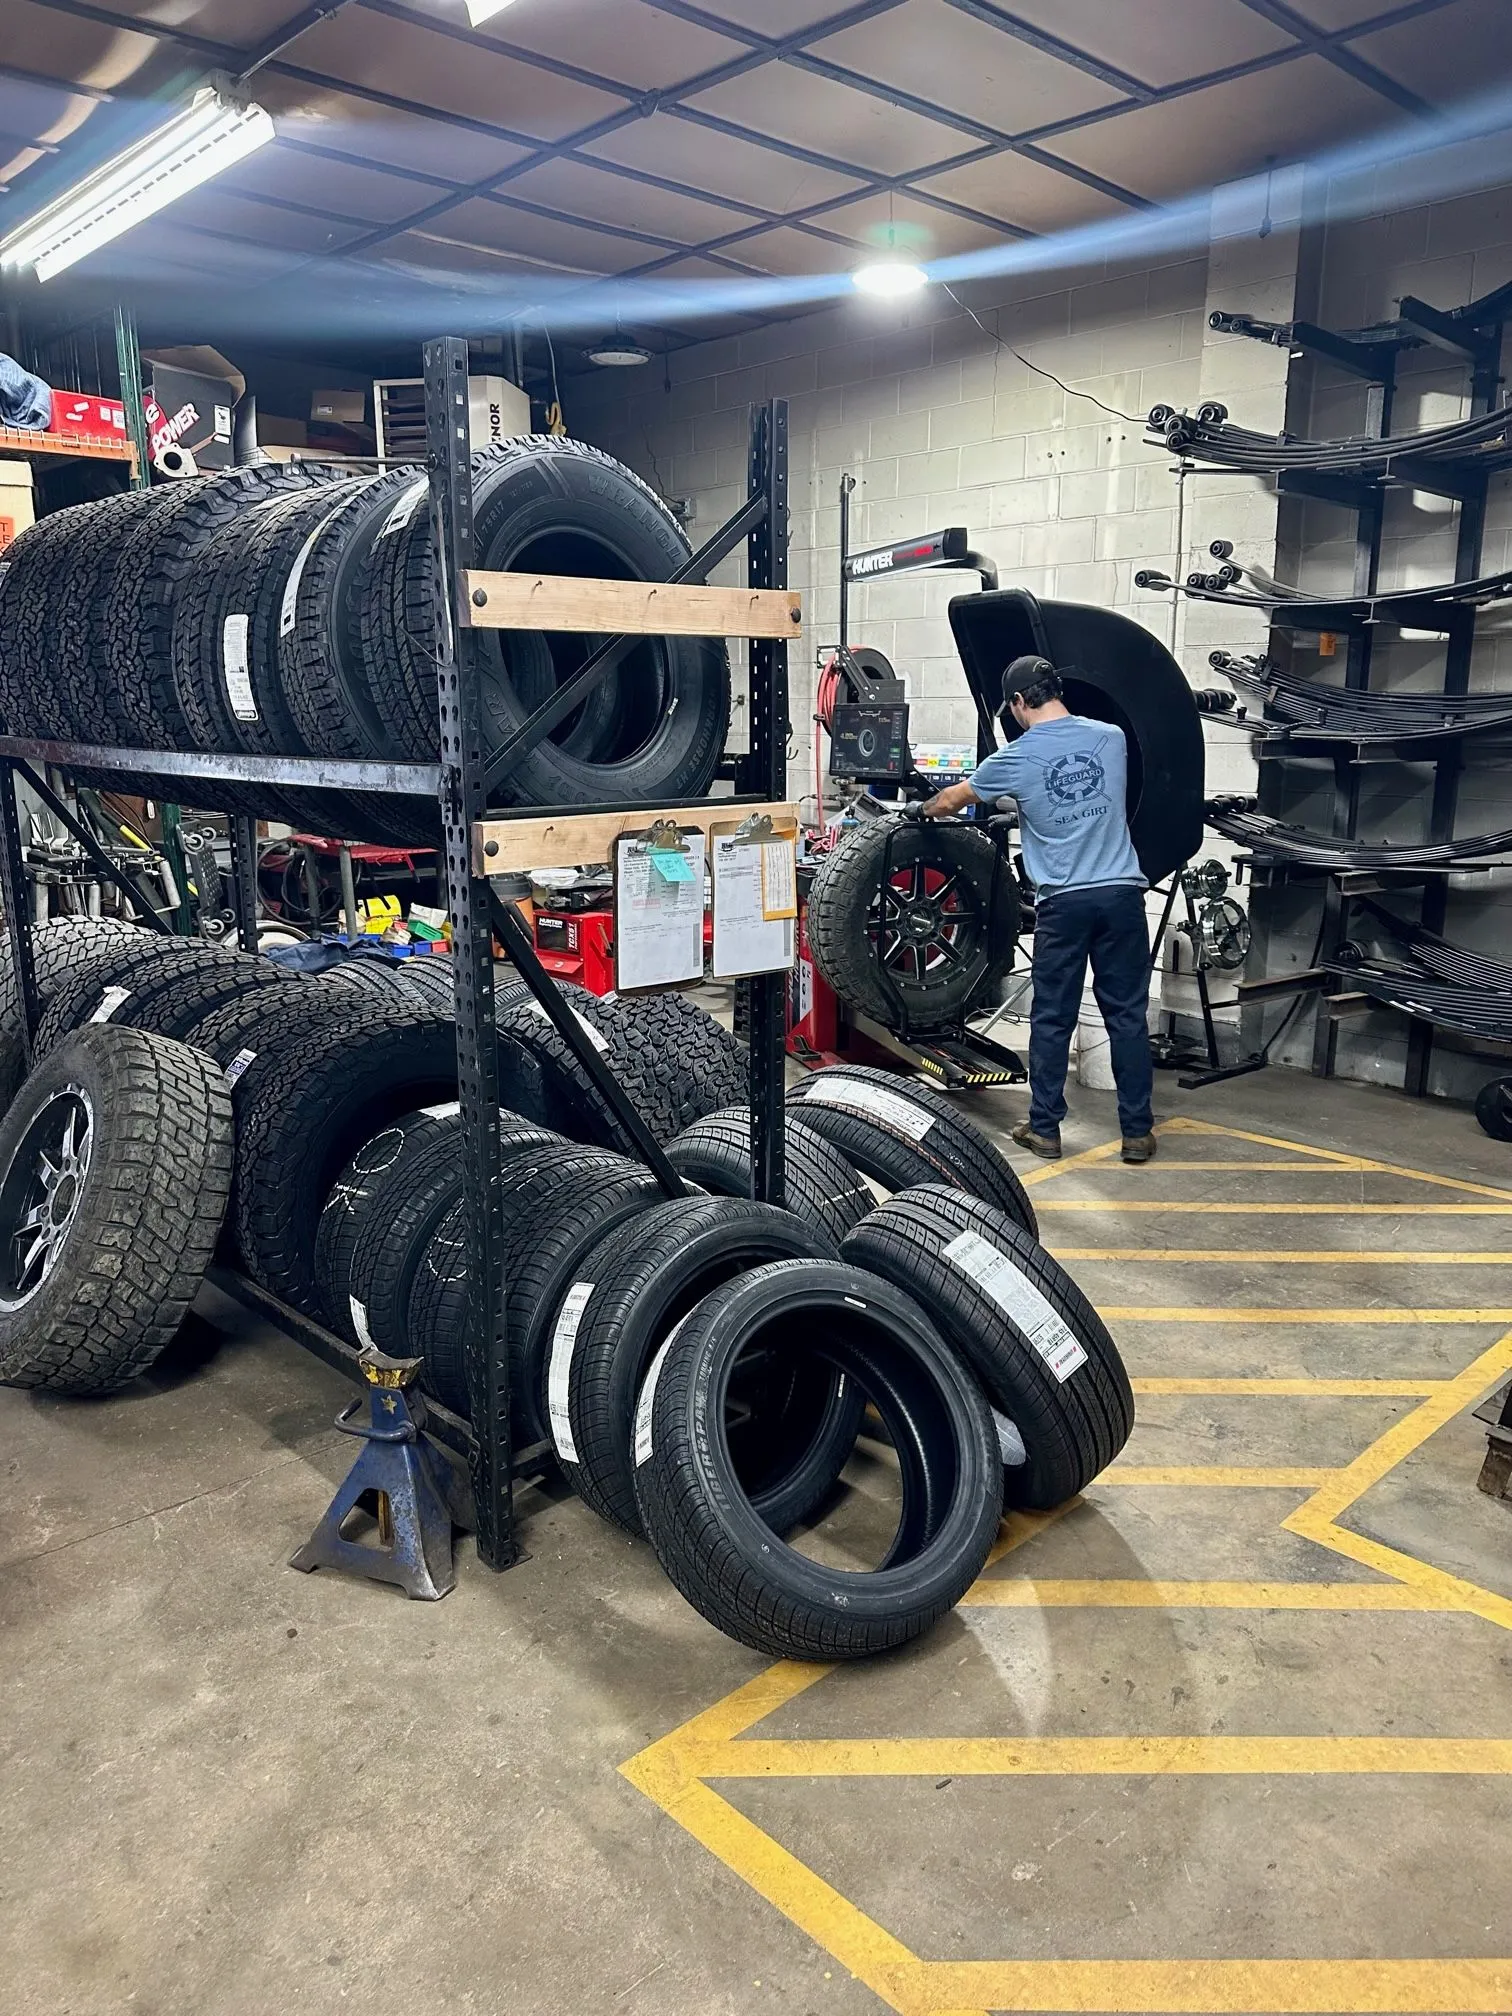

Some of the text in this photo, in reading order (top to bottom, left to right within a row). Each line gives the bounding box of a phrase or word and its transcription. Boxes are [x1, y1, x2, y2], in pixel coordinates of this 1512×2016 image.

[152, 402, 201, 452] POWER
[588, 473, 685, 568] WRANGL
[851, 551, 894, 575] HUNTER
[690, 689, 717, 771] WORKHORSE
[1047, 768, 1102, 788] LIFEGUARD
[1055, 805, 1108, 825] SEA GIRT
[539, 917, 563, 927] HUNTER
[695, 1390, 708, 1439] PAW
[701, 1453, 732, 1511] TIGER
